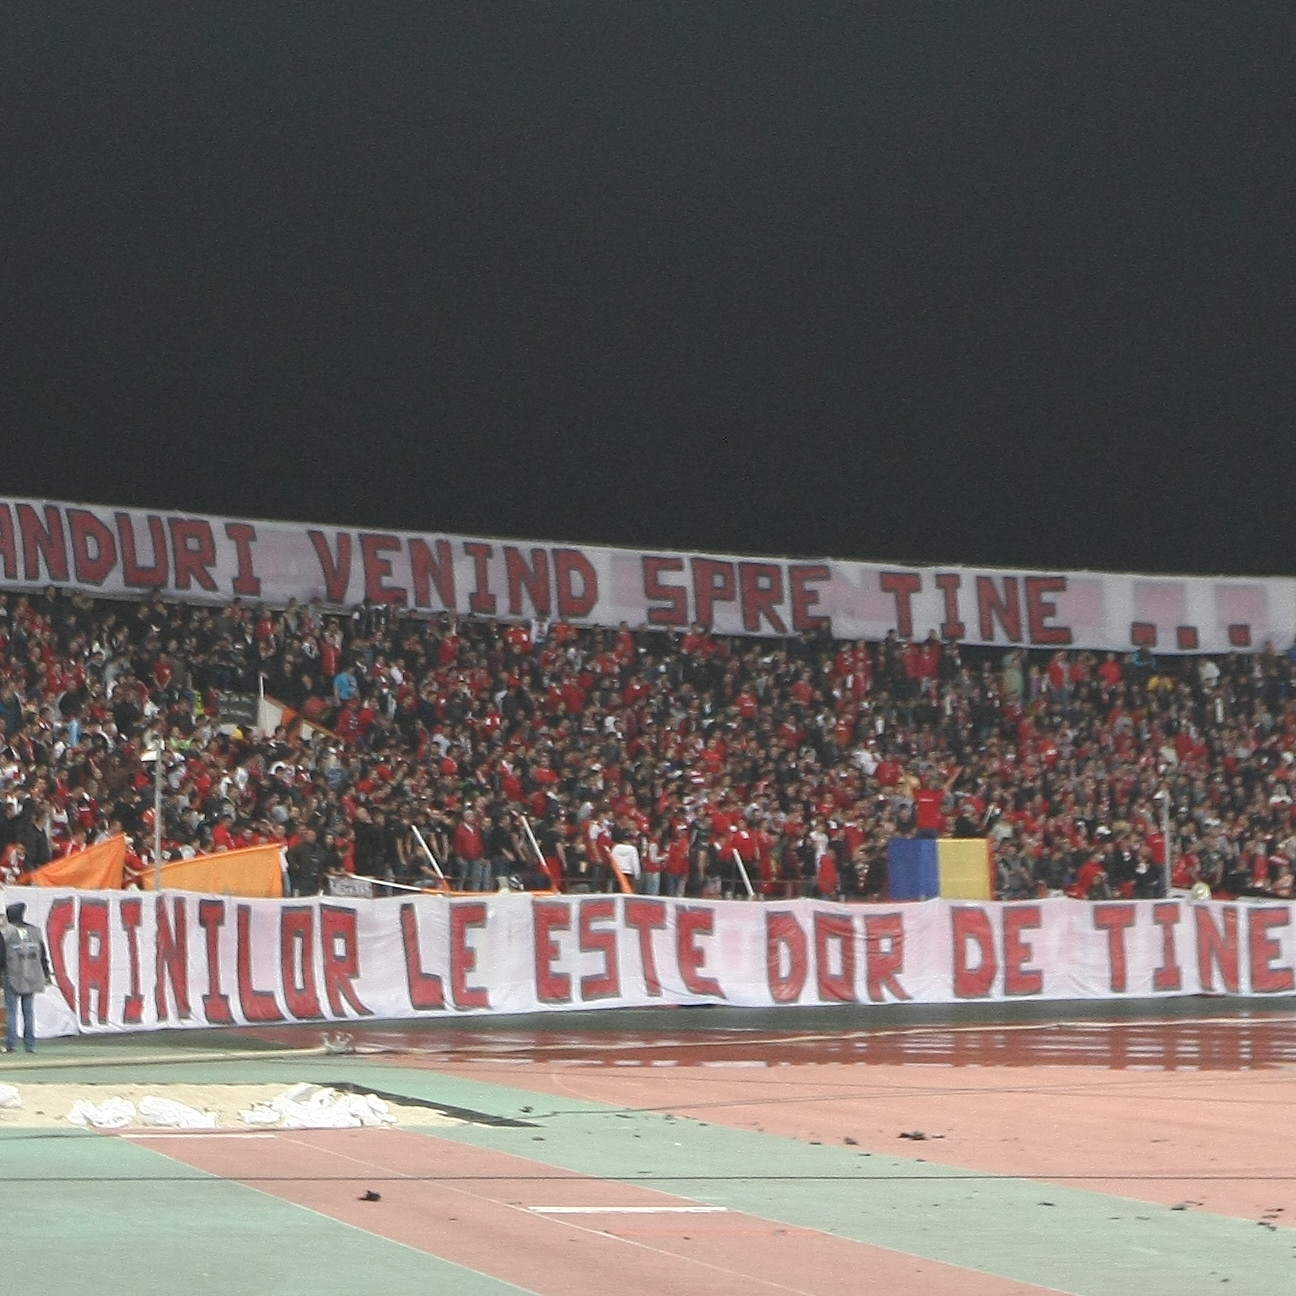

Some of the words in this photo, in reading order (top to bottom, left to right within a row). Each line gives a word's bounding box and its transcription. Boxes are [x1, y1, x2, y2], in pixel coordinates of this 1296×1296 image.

[307, 530, 598, 618] VENIND
[643, 555, 832, 632] SPRE
[880, 571, 1072, 646] TINE
[46, 895, 375, 1027] CAINILOR
[400, 904, 490, 1011] LE
[534, 901, 726, 1004] ESTE
[766, 910, 911, 1004] DOR
[952, 905, 1044, 999] DE
